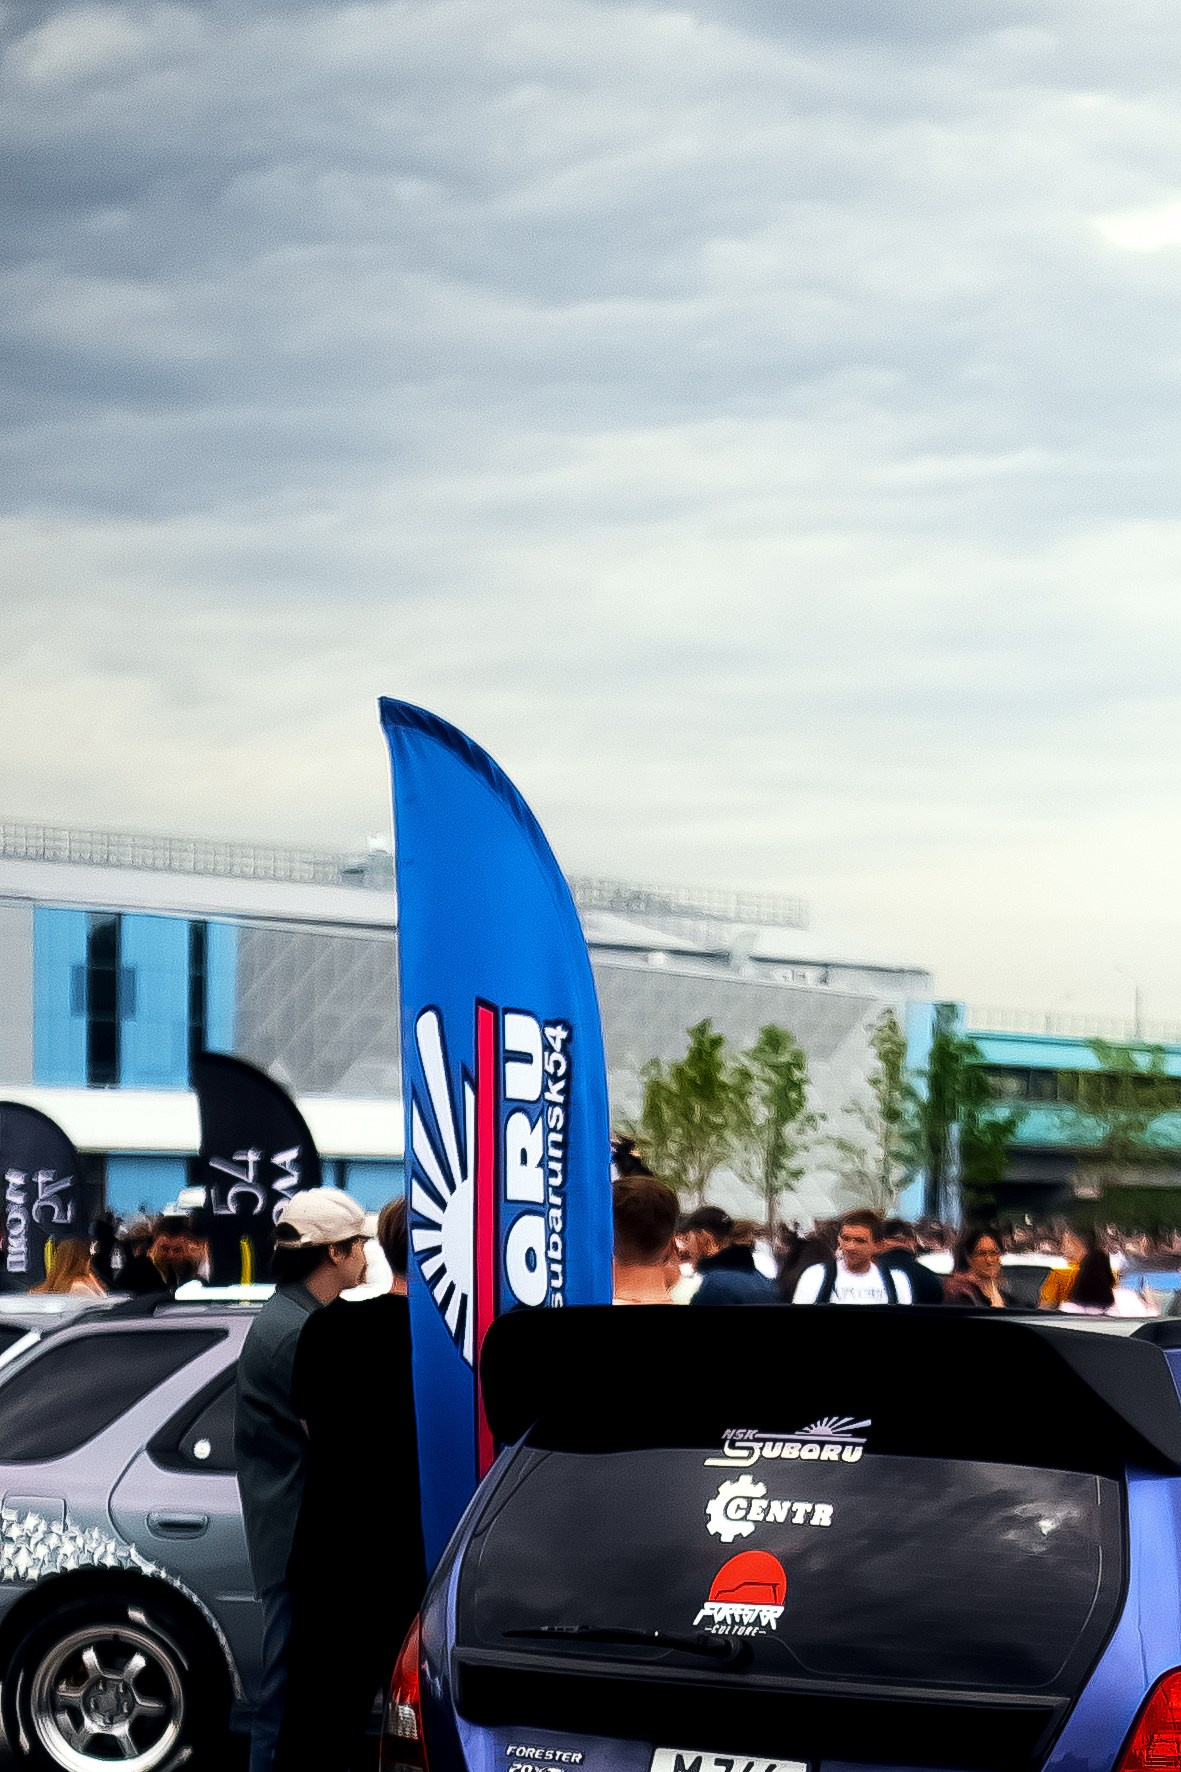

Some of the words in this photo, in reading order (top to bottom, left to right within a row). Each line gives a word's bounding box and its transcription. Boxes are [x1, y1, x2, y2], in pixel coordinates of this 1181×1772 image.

[209, 1148, 266, 1216] 54
[721, 1428, 759, 1440] NSK
[703, 1438, 863, 1468] SUBARU
[725, 1496, 834, 1527] CENTR
[506, 1745, 583, 1764] FORESTER
